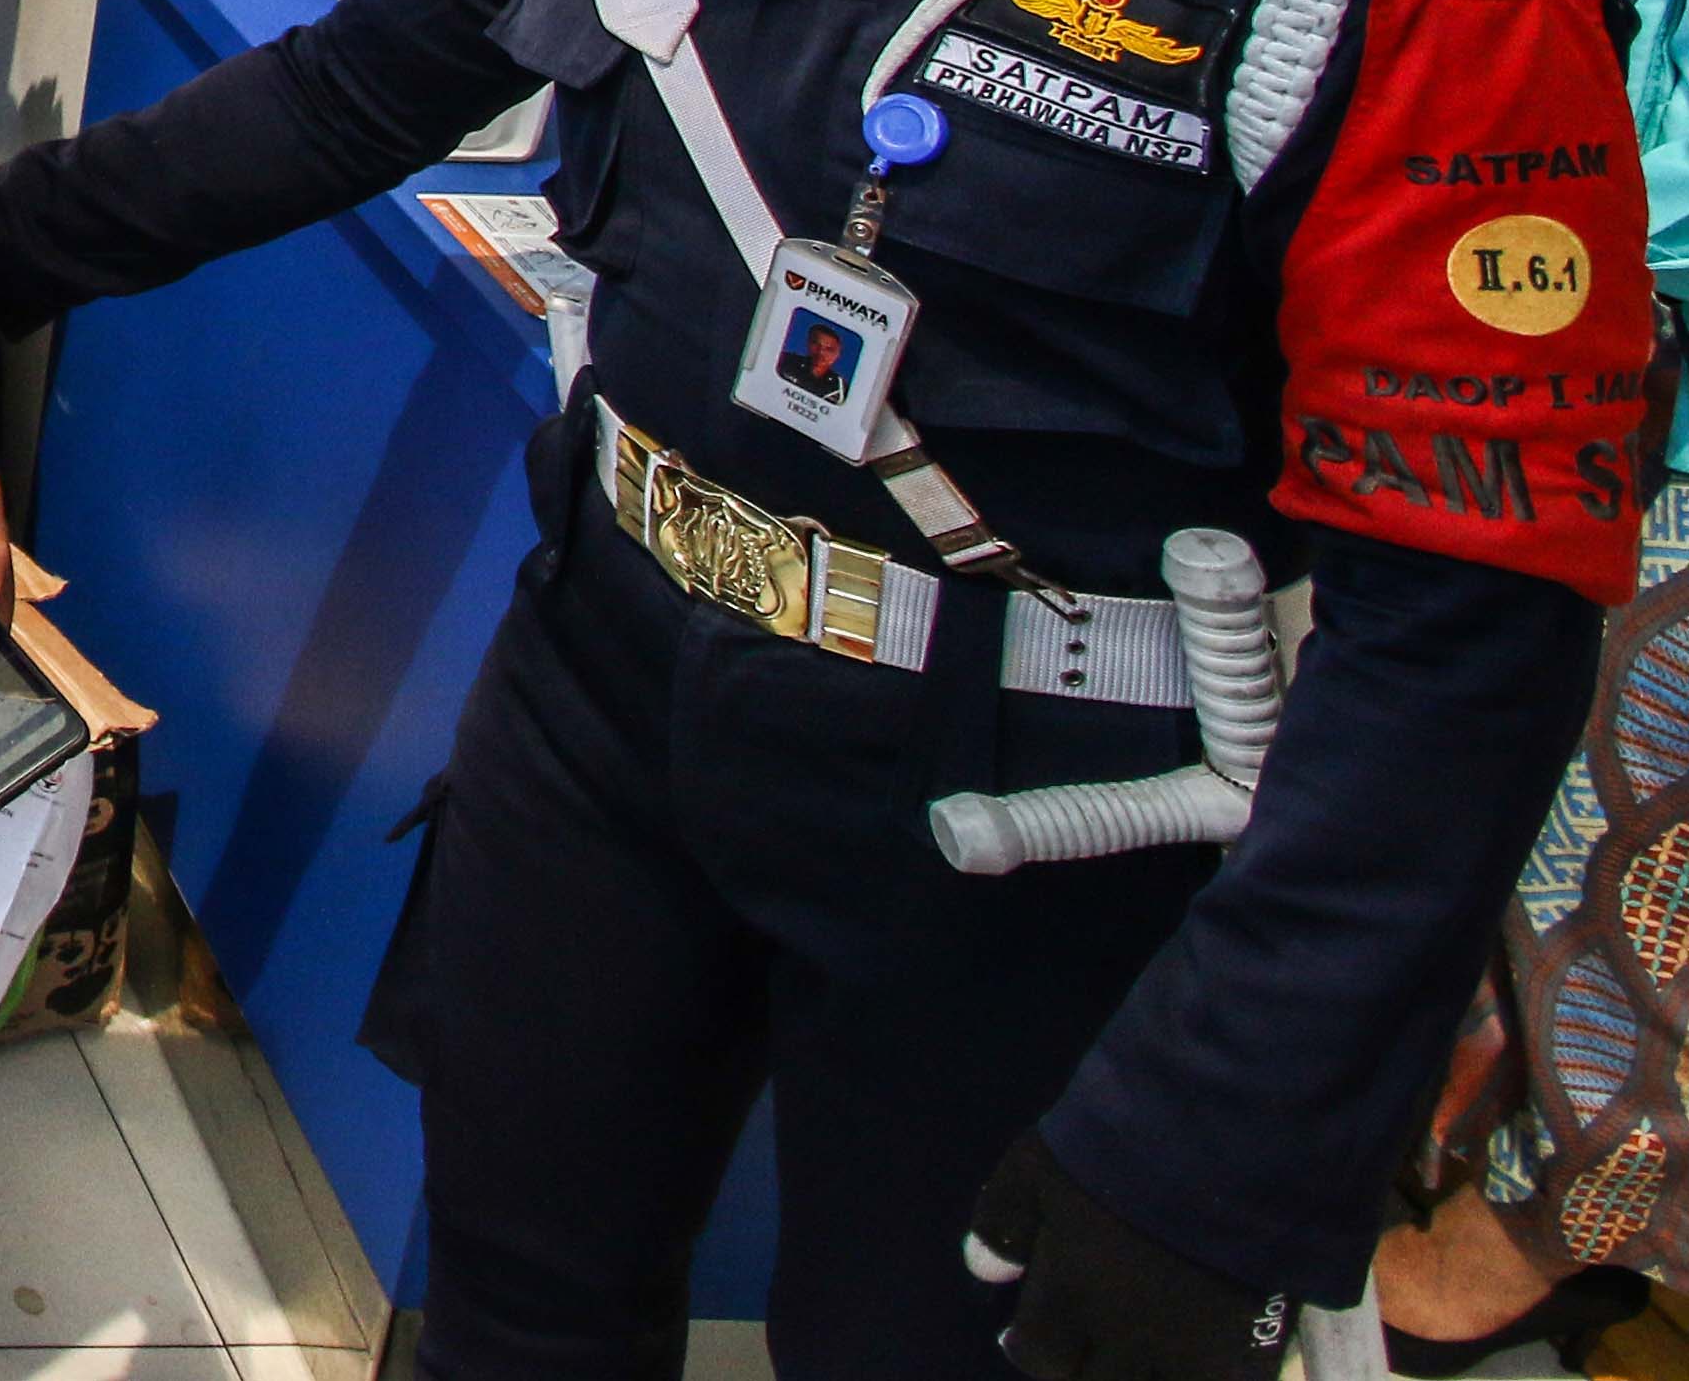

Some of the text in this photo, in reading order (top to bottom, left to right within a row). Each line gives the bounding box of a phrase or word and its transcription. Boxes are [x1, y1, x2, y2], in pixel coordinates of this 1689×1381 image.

[971, 49, 1174, 136] SATPAM
[1124, 134, 1192, 163] NSP
[1404, 143, 1611, 186] SATPAM
[806, 281, 889, 327] BHAWATA
[782, 387, 817, 409] AGUS
[1364, 365, 1527, 408] DAOP
[1296, 416, 1539, 523] PAM
